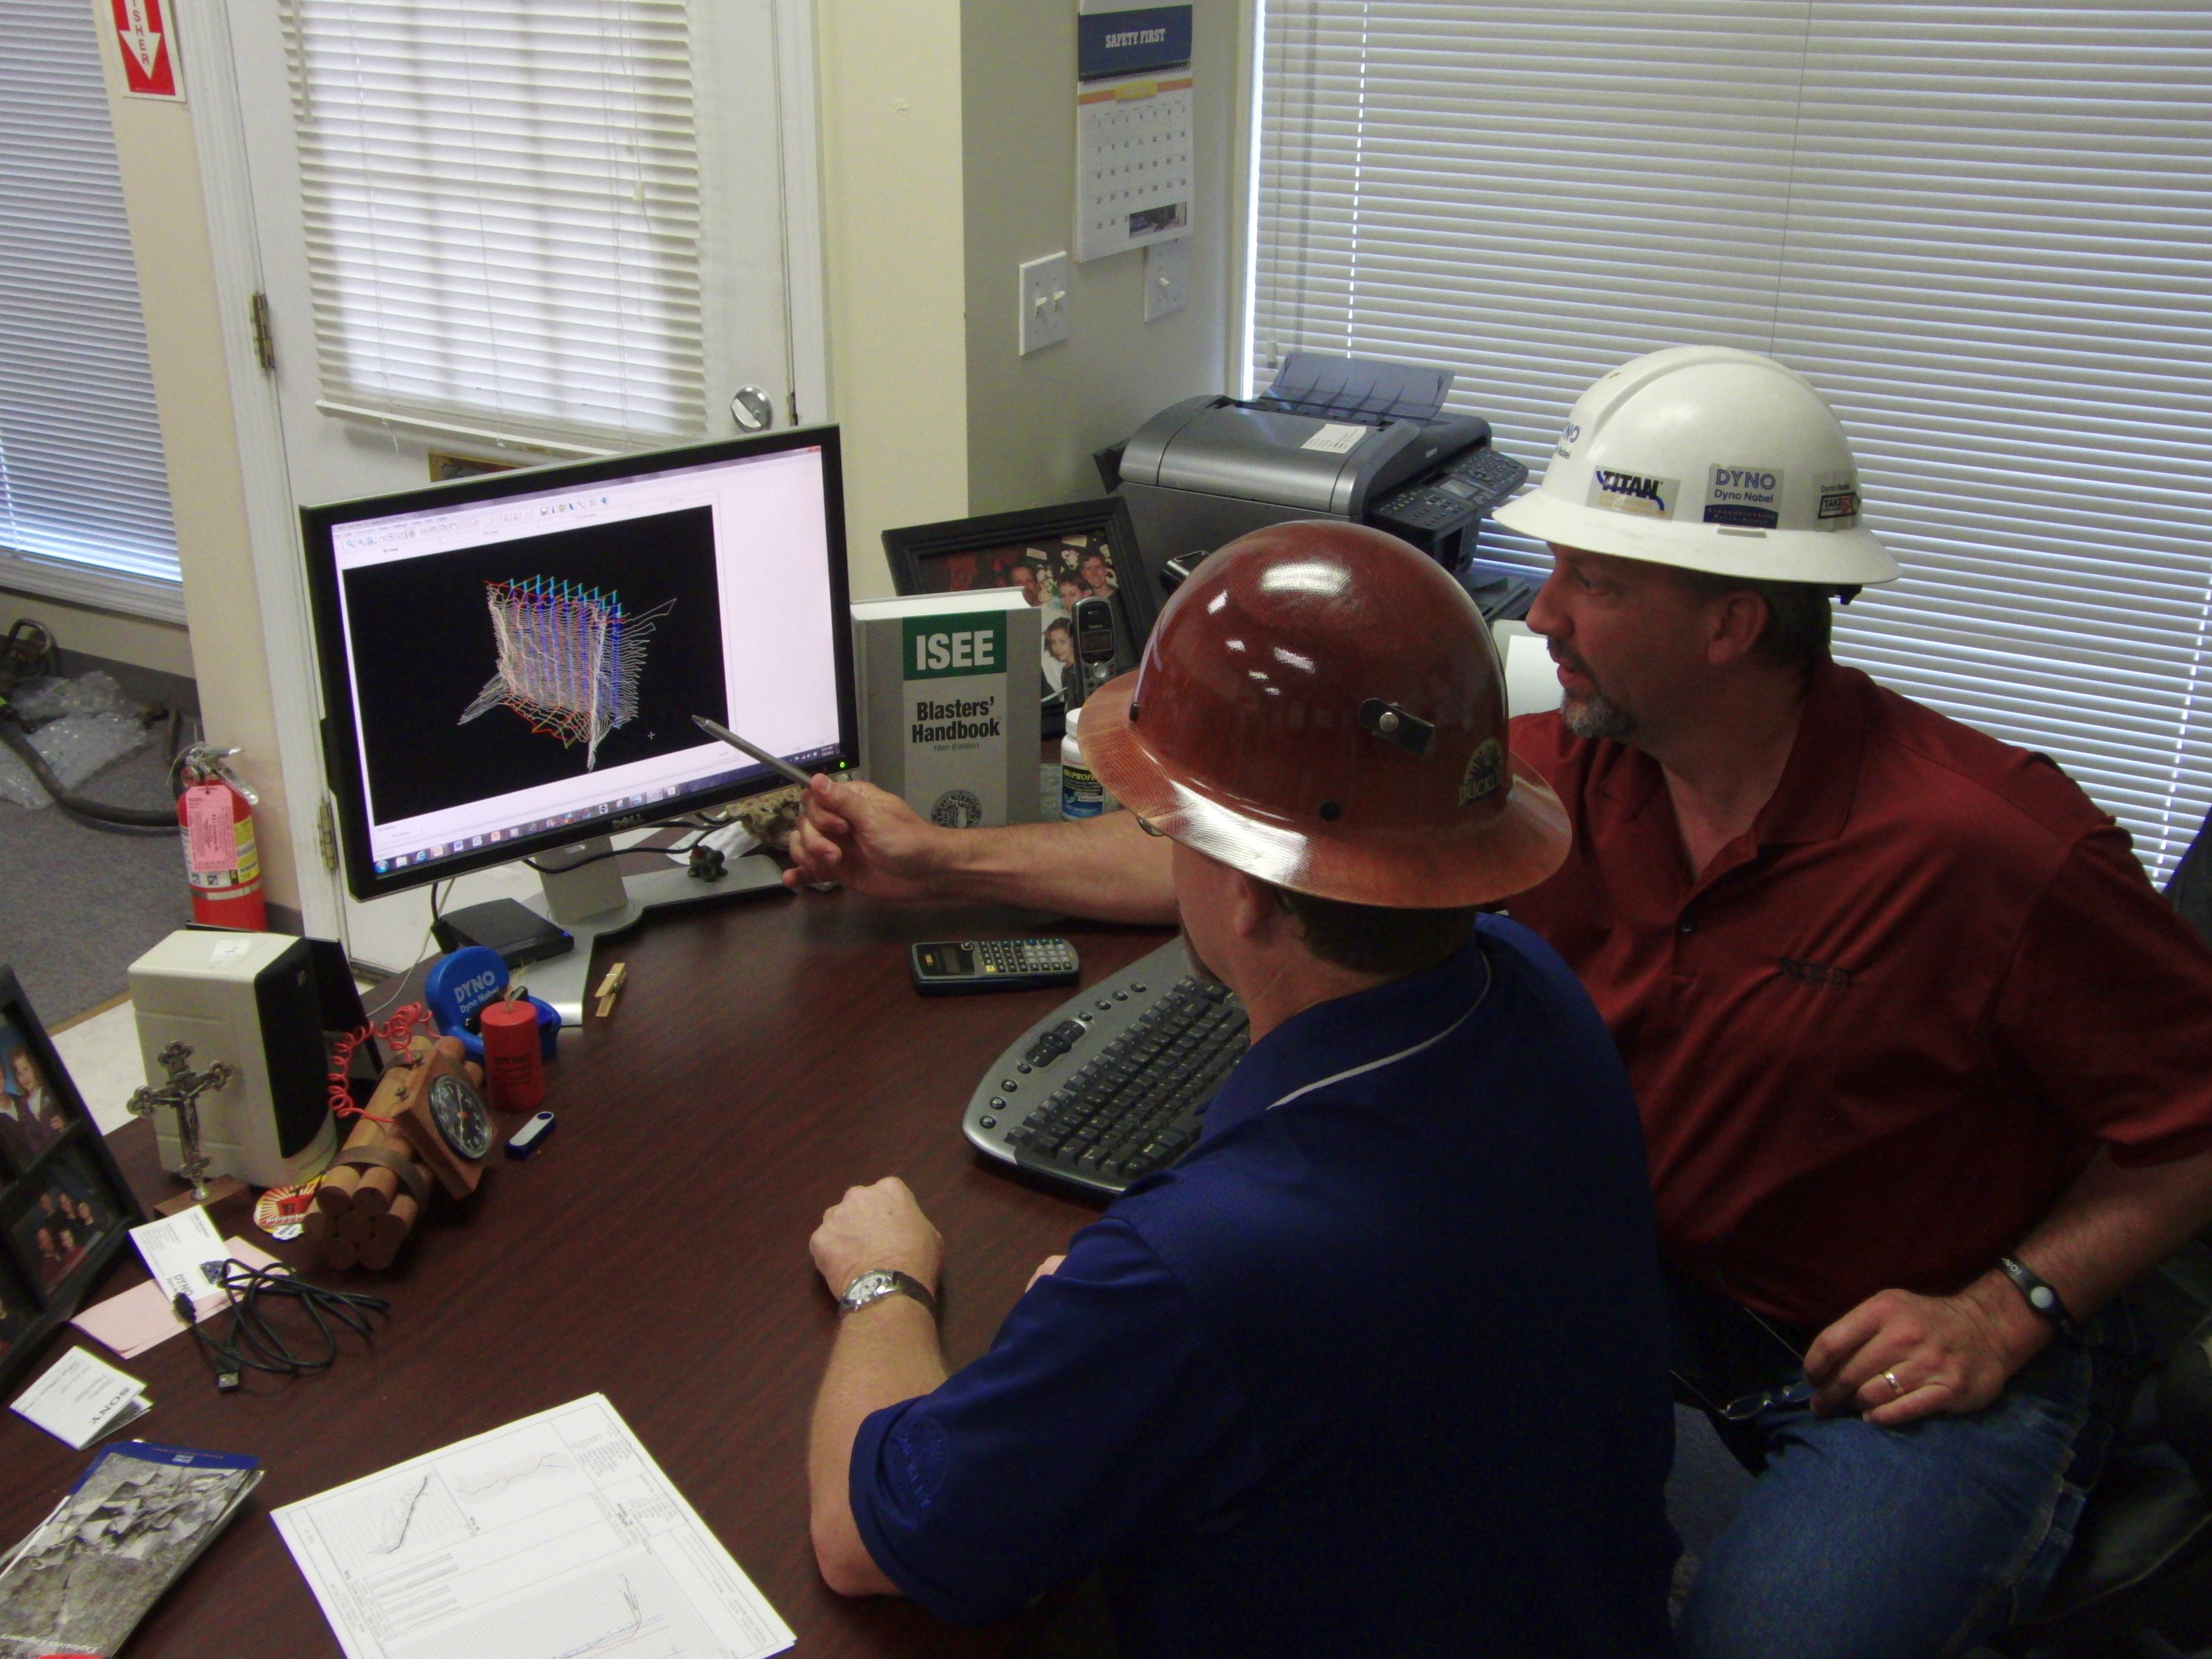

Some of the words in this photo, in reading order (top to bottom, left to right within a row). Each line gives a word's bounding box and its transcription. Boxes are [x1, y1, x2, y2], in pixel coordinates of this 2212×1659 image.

[1105, 32, 1139, 48] SAFETY
[1141, 28, 1166, 44] FIRST
[1602, 470, 1659, 500] TITAN
[1715, 469, 1776, 490] DYNO
[1714, 489, 1741, 501] Dyno
[1744, 492, 1774, 503] Nobel
[916, 630, 994, 671] ISEE
[917, 696, 994, 721] Blasters'
[912, 717, 1000, 743] Handbook
[951, 742, 979, 750] Edition
[454, 971, 495, 1003] DYNO
[460, 999, 478, 1013] Dyno
[478, 986, 499, 1002] Nobel
[173, 1273, 193, 1296] DYNO
[90, 1385, 130, 1426] SONY
[48, 1641, 98, 1654] Explosives
